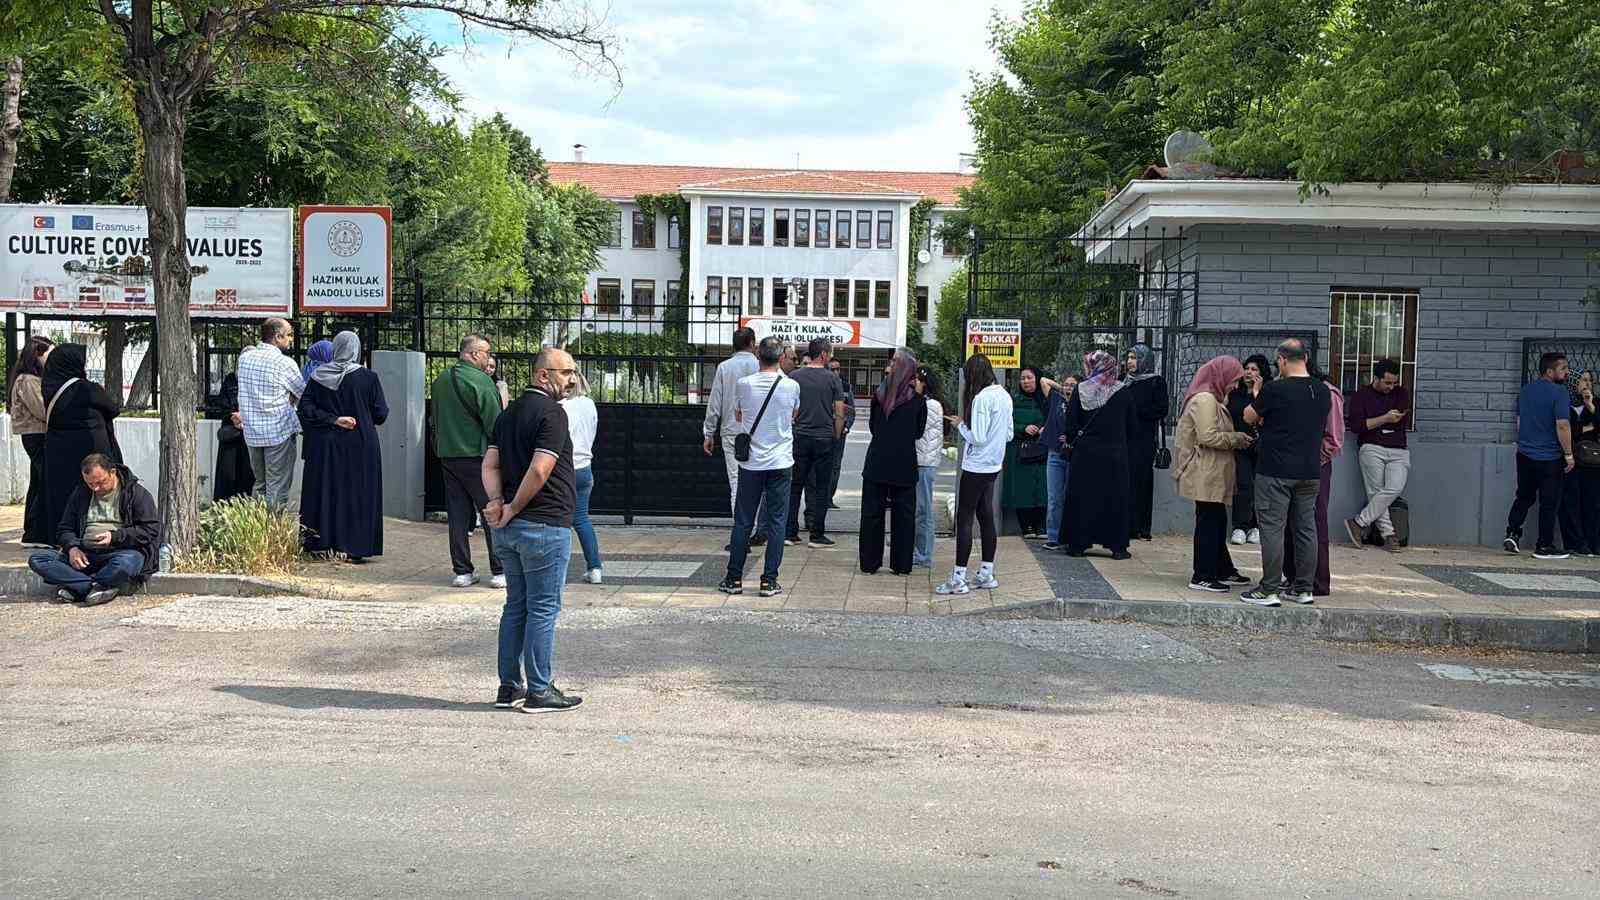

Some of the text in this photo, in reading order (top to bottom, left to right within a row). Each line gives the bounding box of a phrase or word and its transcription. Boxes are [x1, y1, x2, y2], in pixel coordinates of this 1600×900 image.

[95, 222, 142, 231] Erasmus+
[8, 235, 96, 254] CULTURE
[186, 238, 263, 257] VALUES
[312, 275, 379, 285] HAZIM KULAK
[307, 287, 384, 297] ANADOLU LİSESİ
[802, 325, 833, 334] KULAK
